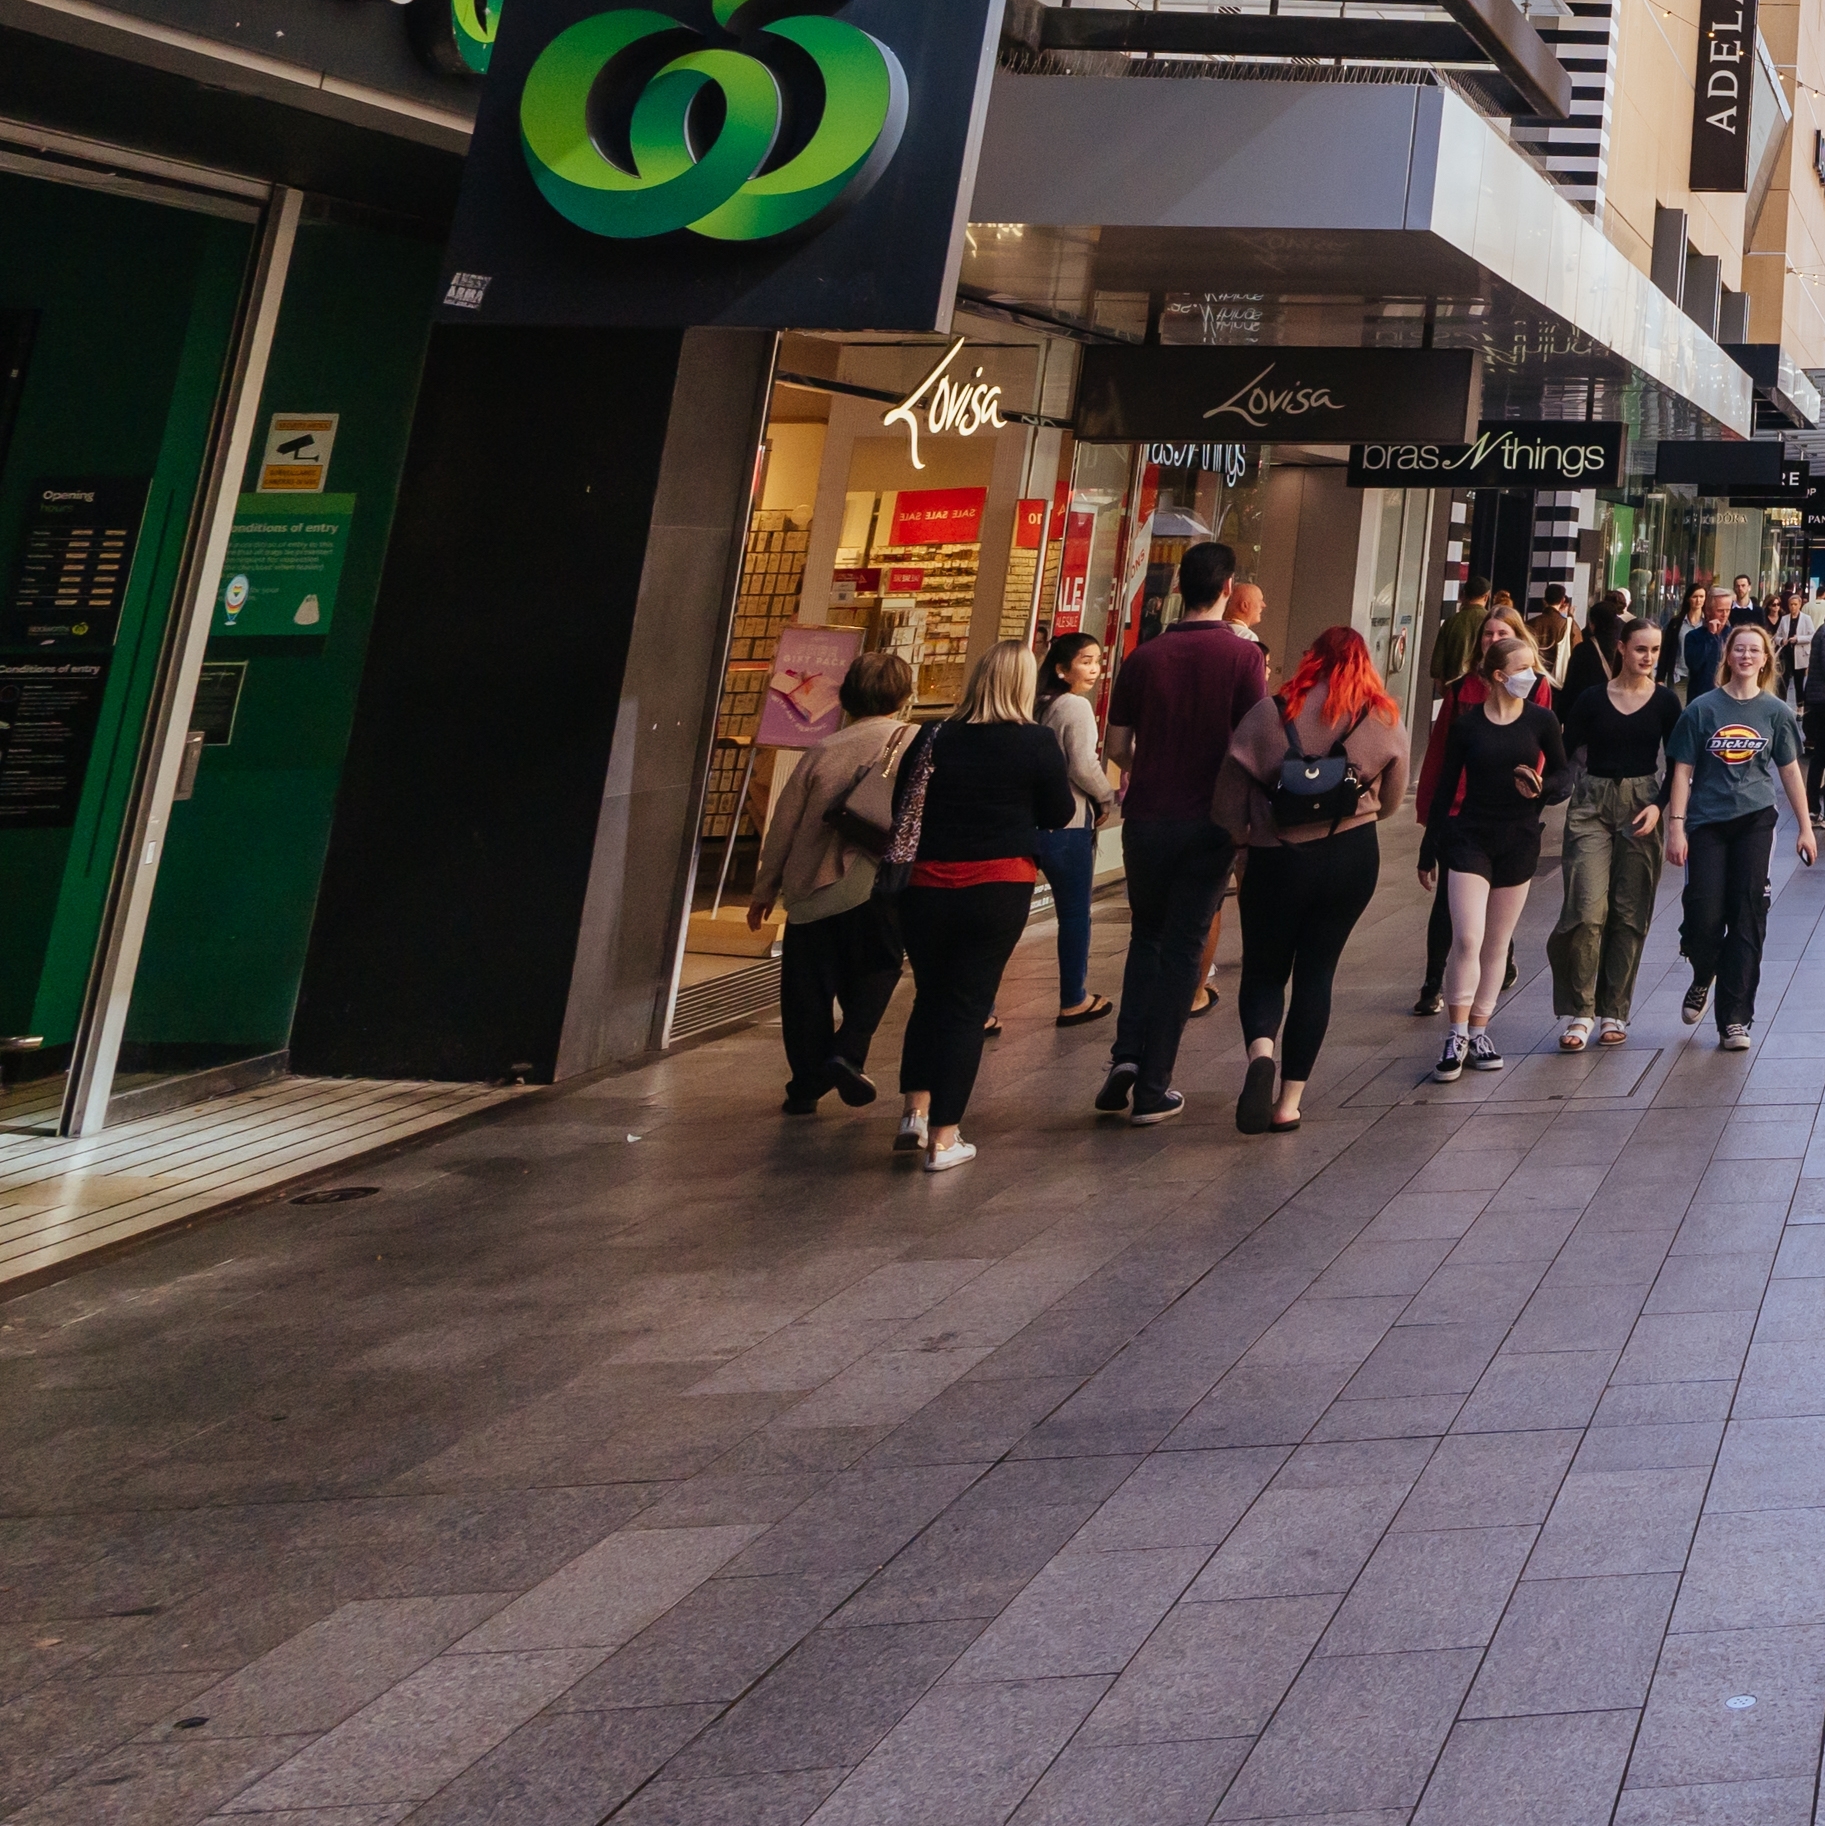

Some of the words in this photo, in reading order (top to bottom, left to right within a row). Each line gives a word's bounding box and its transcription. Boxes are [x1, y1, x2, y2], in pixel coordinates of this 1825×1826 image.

[1203, 362, 1345, 427] Lovisa
[884, 337, 1007, 469] Lovisa
[1362, 444, 1439, 470] bras
[1501, 437, 1605, 478] things
[43, 490, 95, 502] Opening
[232, 523, 287, 533] onditions
[290, 523, 304, 533] of
[305, 524, 339, 535] entry
[783, 654, 811, 663] GIFT
[816, 656, 847, 667] PACK
[57, 664, 71, 674] of
[71, 665, 100, 675] entry
[1709, 739, 1763, 749] Dickies
